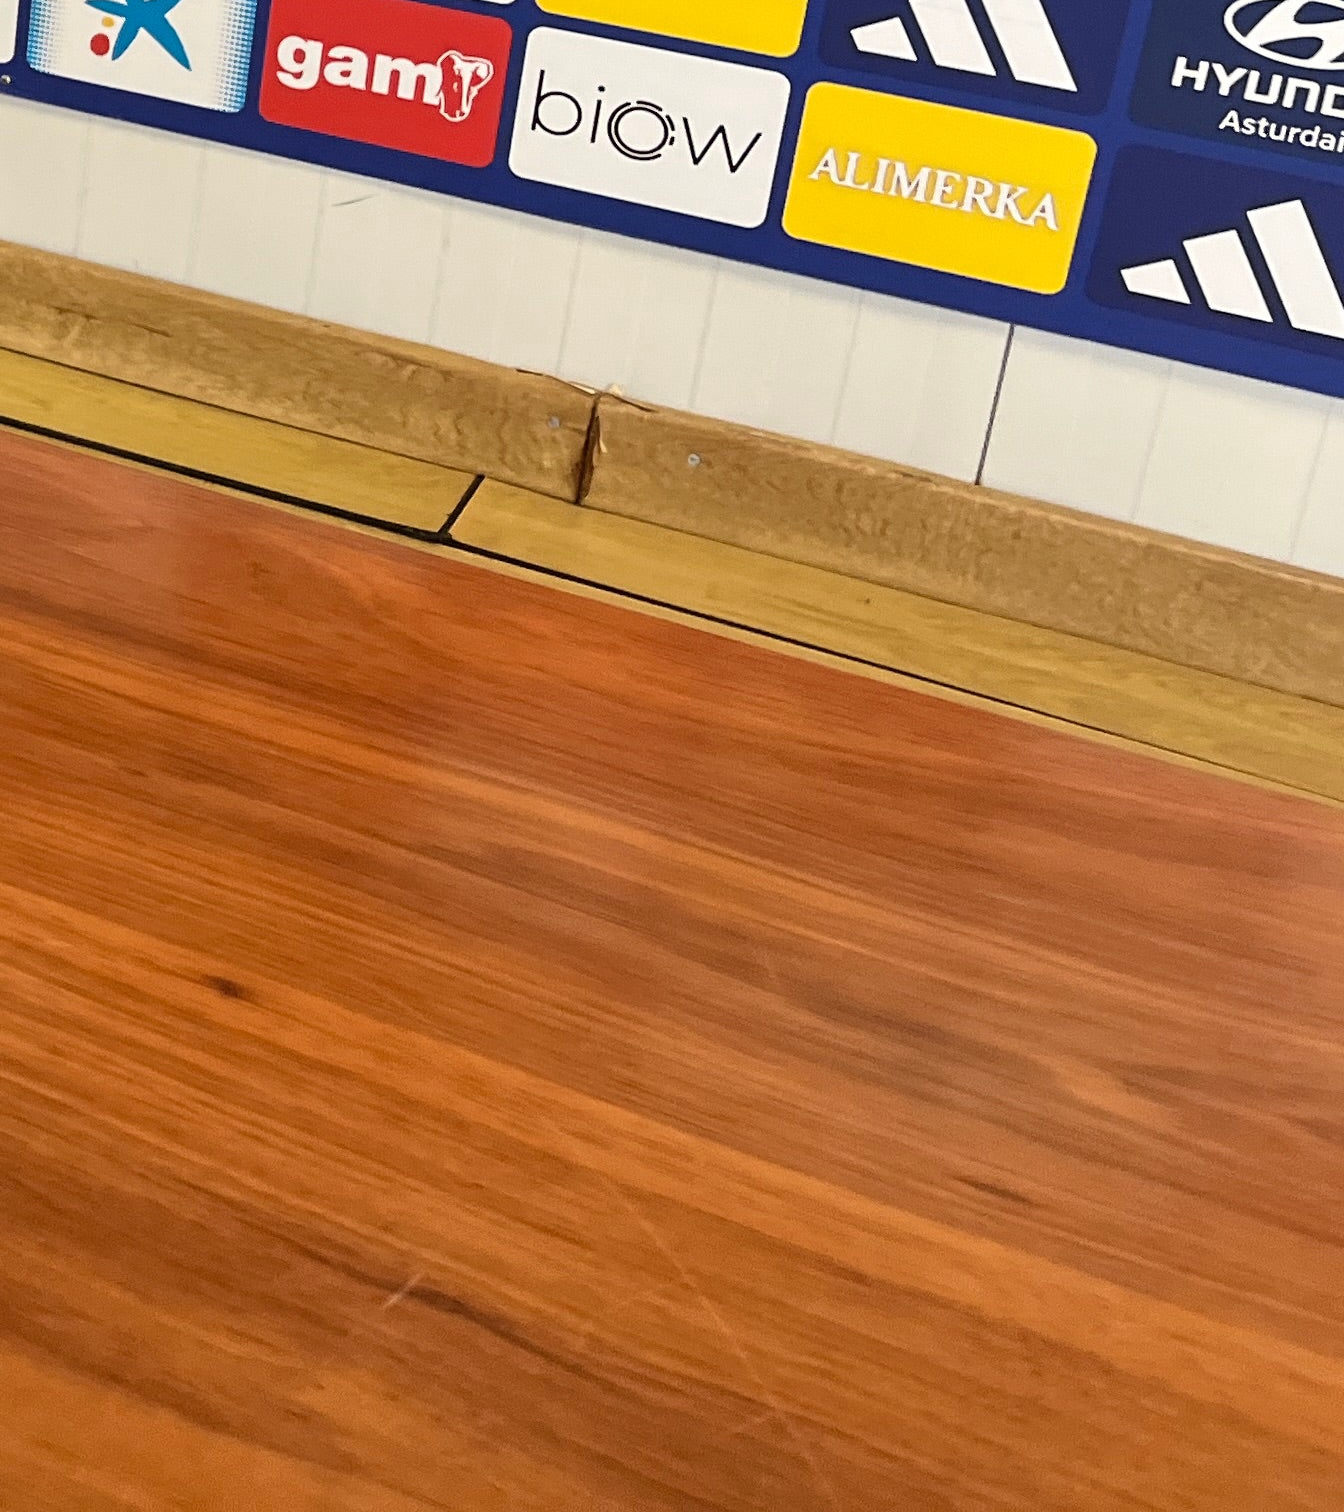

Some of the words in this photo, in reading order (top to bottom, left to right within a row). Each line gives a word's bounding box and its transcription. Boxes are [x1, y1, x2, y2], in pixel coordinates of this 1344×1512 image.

[276, 33, 440, 107] gam
[1171, 56, 1344, 119] HYUND
[531, 69, 762, 174] biow
[808, 146, 1061, 233] ALIMERKA
